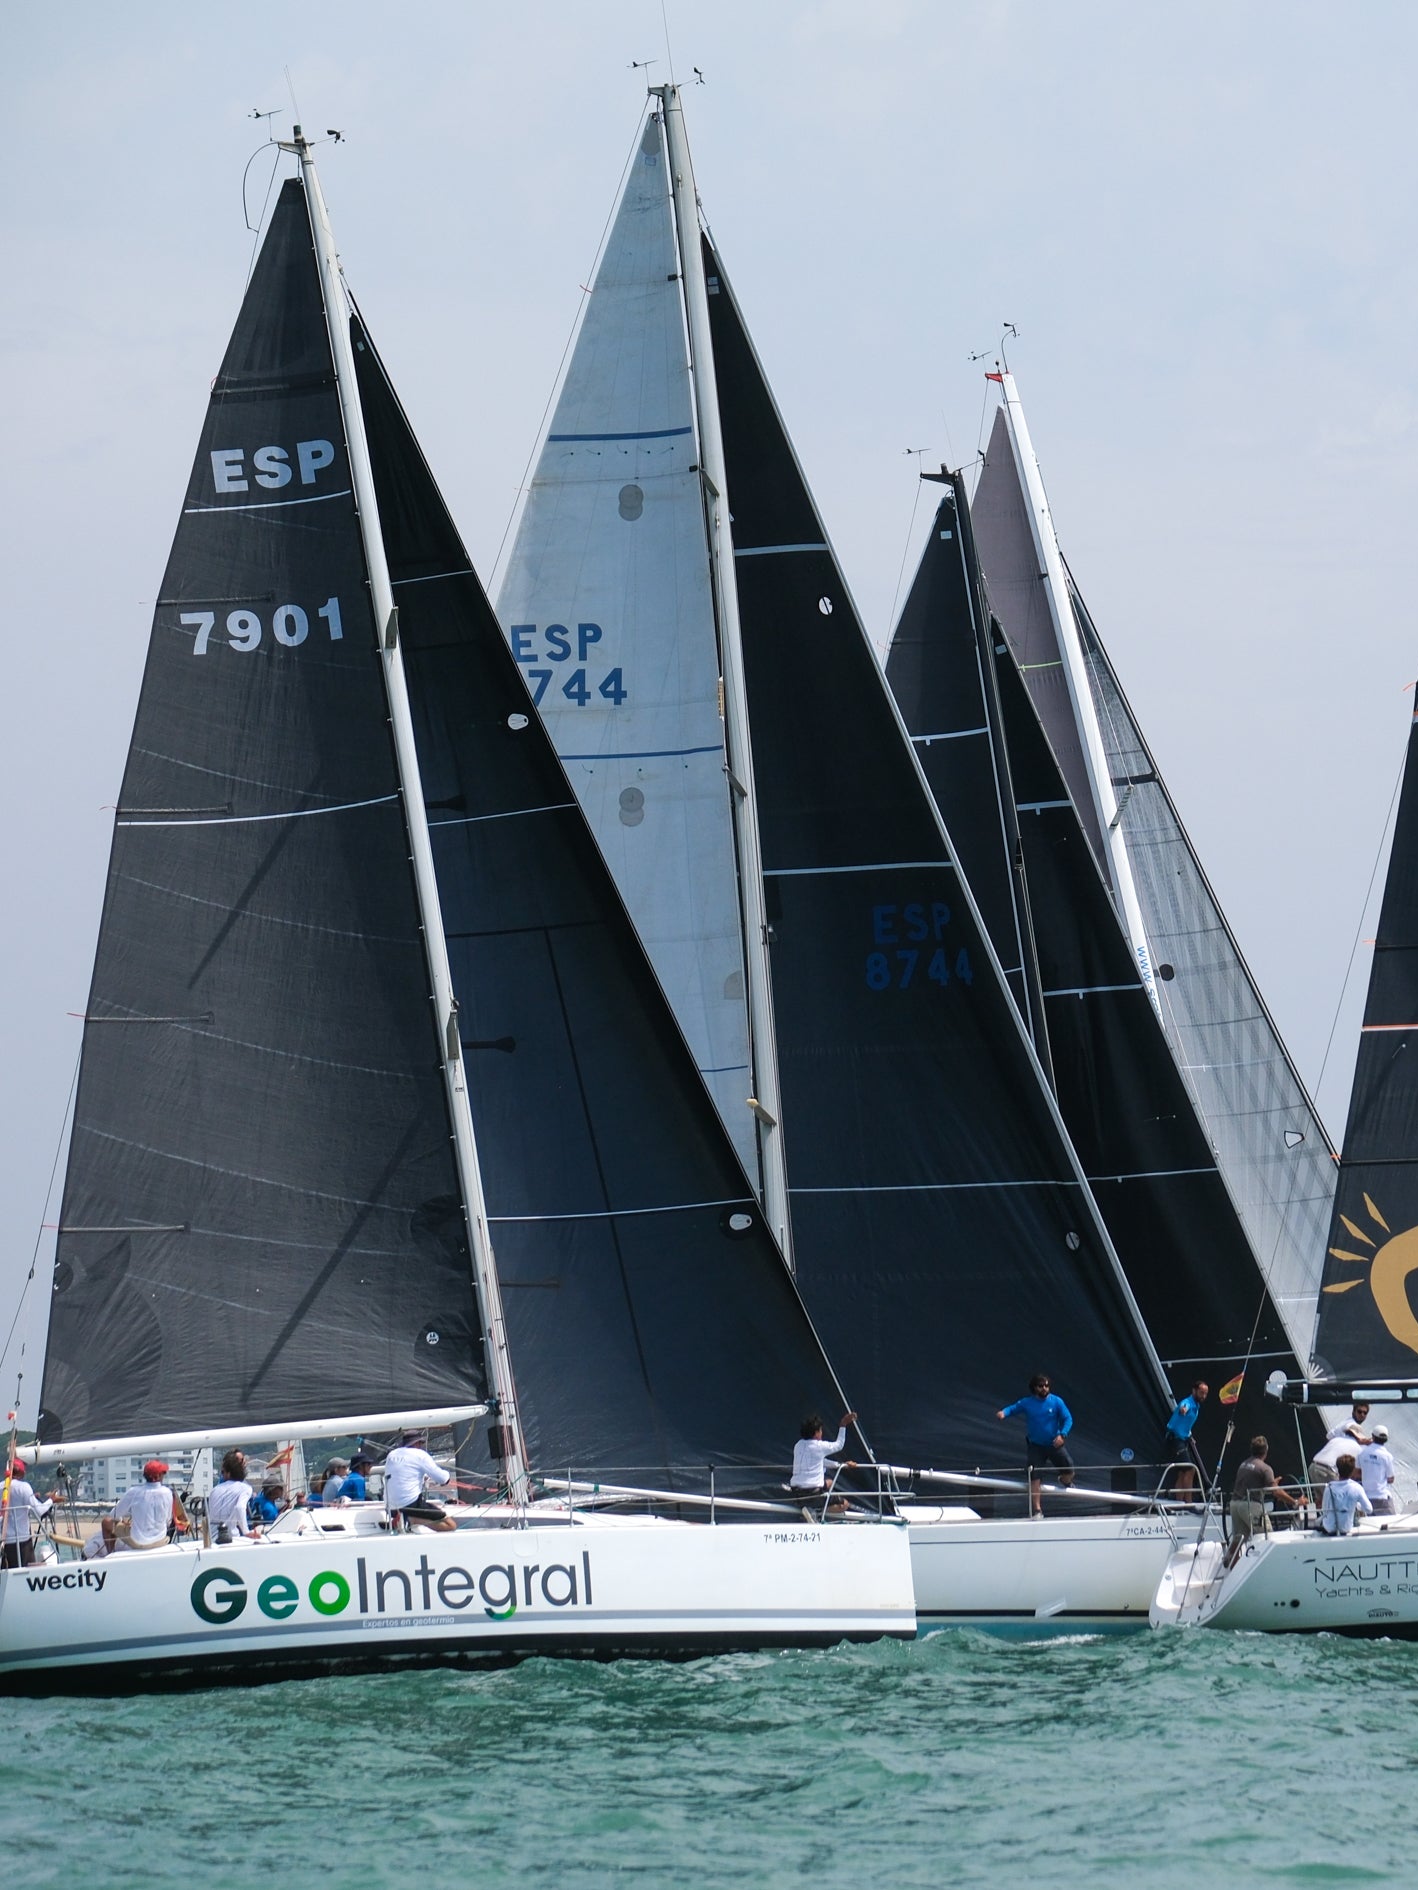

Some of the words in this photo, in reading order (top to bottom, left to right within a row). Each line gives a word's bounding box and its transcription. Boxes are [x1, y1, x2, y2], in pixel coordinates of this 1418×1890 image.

[210, 439, 335, 494] ESP
[179, 597, 344, 656] 7901
[511, 623, 602, 662] ESP
[528, 668, 627, 707] 744
[872, 902, 952, 945] ESP
[865, 947, 973, 992] 8744
[774, 1533, 821, 1543] PM-2-74-21
[27, 1569, 107, 1592] wecity
[190, 1550, 593, 1624] GeoIntegral
[1315, 1586, 1374, 1598] Yachts
[1379, 1585, 1391, 1595] &
[361, 1619, 399, 1629] Expertos
[412, 1616, 455, 1627] geotermia
